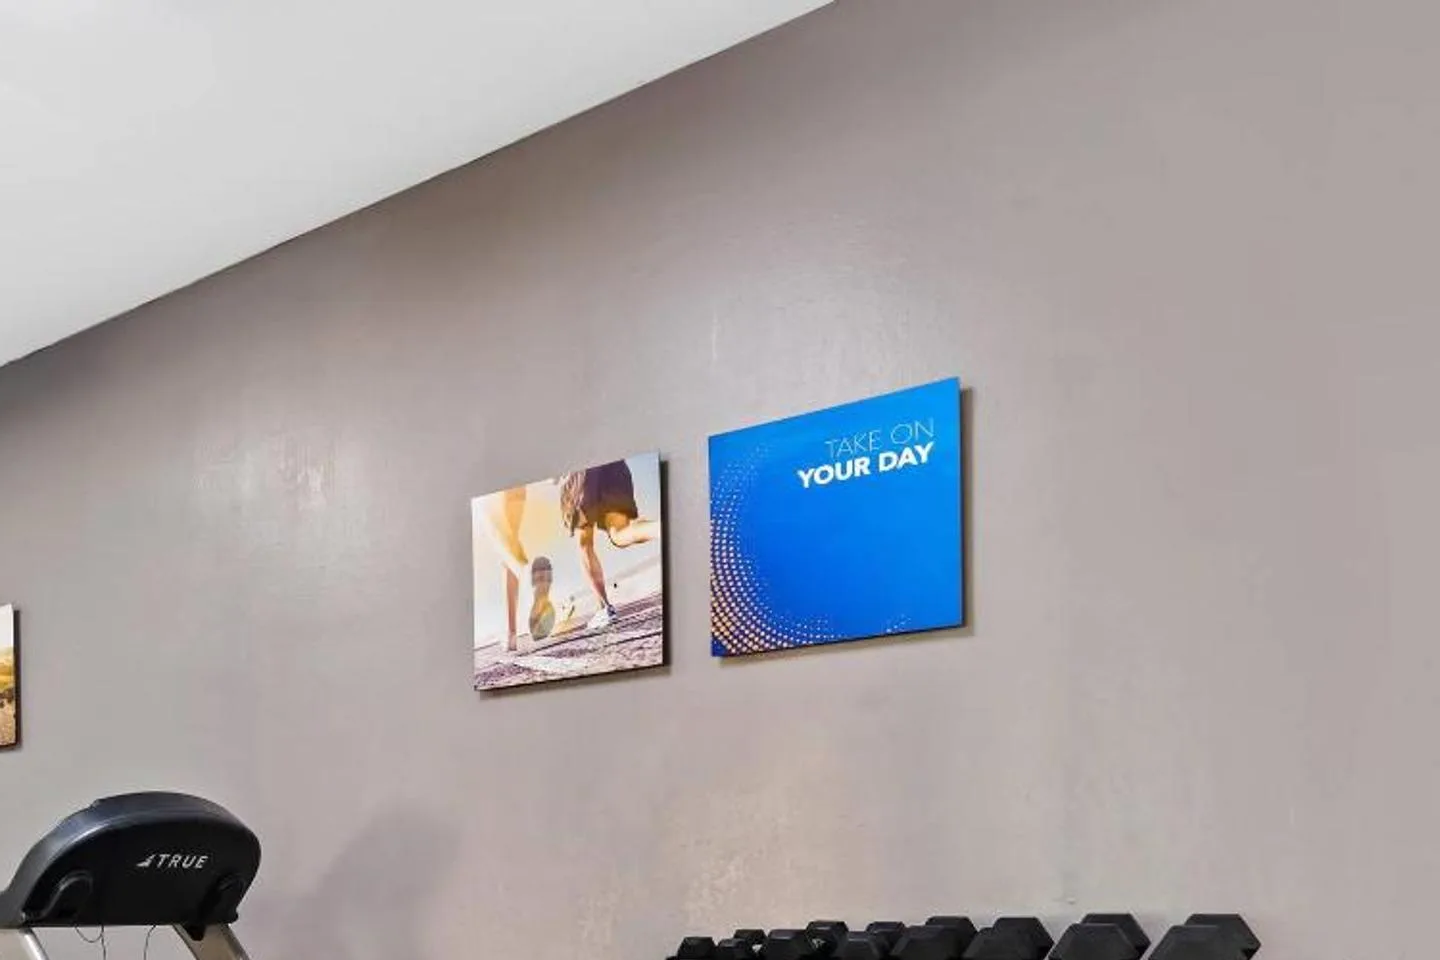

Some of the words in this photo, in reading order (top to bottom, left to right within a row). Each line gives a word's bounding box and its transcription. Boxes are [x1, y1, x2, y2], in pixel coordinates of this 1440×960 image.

[824, 429, 881, 459] TAKE
[890, 417, 935, 445] ON
[796, 456, 871, 489] YOUR
[878, 441, 934, 472] DAY
[157, 853, 209, 869] TRUE
